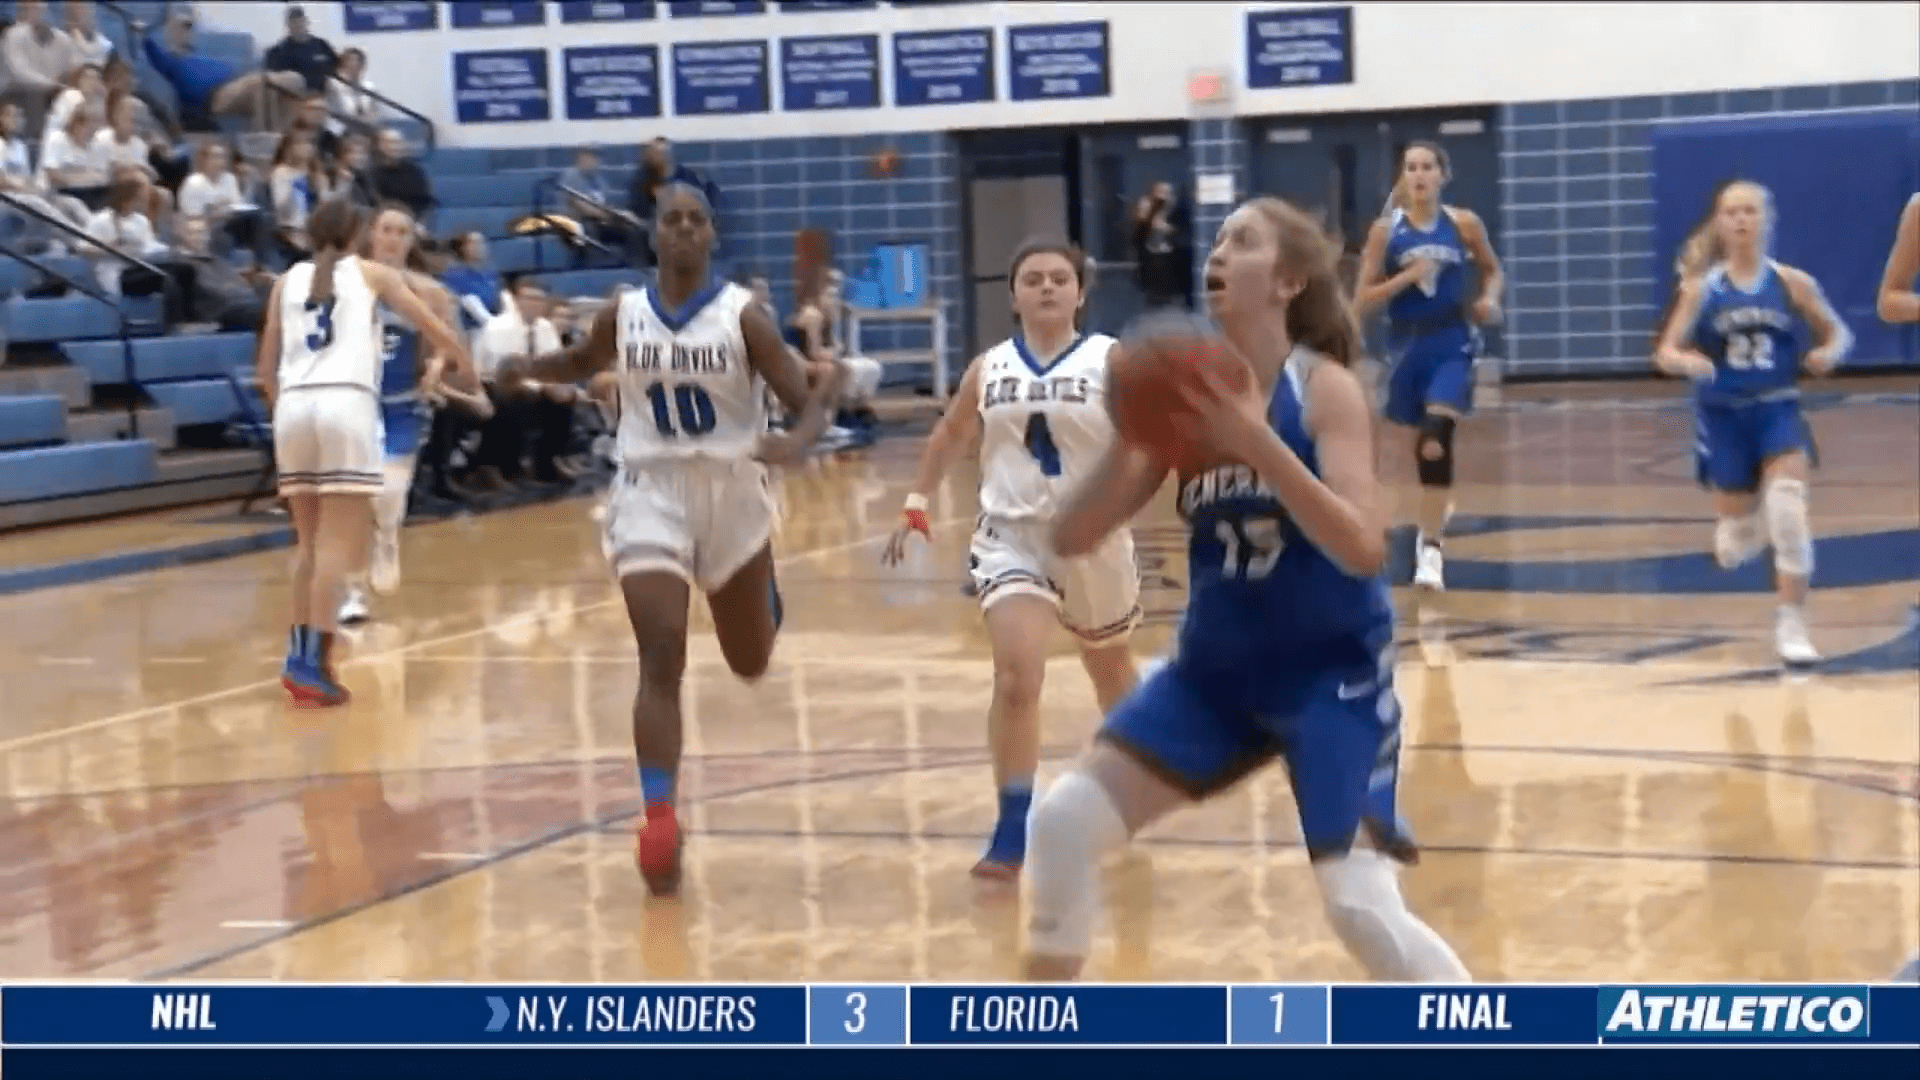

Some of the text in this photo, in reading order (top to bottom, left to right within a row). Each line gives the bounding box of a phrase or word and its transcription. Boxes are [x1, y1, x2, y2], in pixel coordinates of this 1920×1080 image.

[304, 300, 335, 352] 3
[1727, 331, 1775, 371] 22
[645, 380, 717, 438] 10
[1024, 410, 1062, 477] 4
